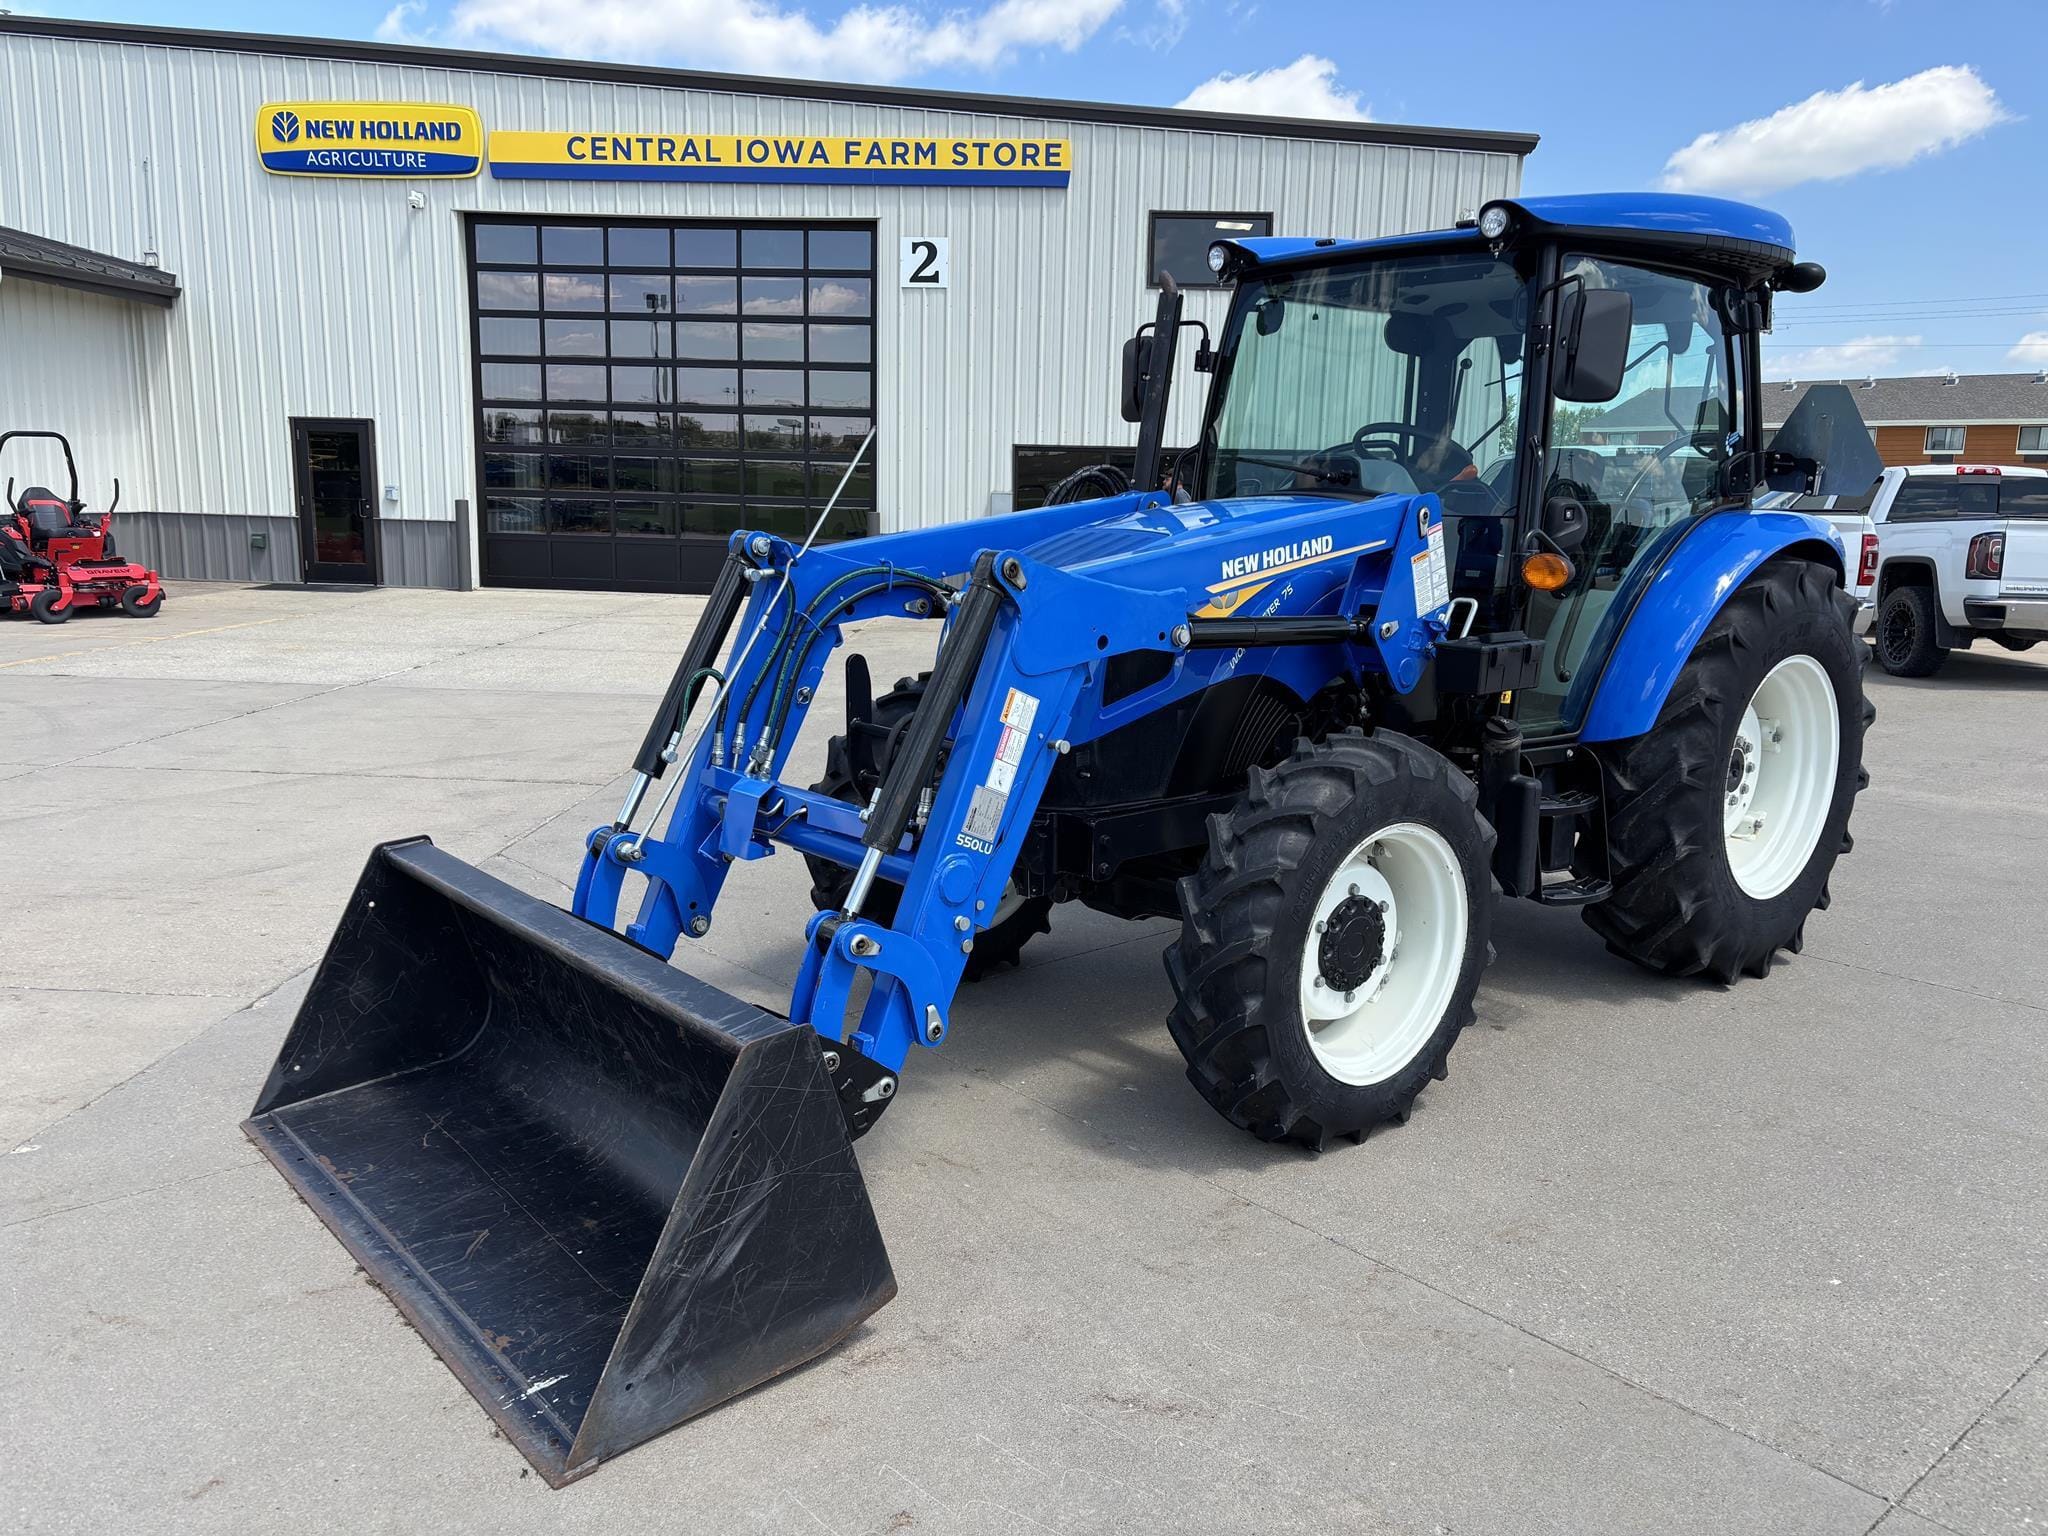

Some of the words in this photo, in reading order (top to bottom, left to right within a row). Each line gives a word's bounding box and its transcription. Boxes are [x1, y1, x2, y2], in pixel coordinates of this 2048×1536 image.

[305, 120, 354, 139] NEW
[360, 121, 462, 141] HOLLAND
[306, 151, 427, 168] AGRICULTURE
[566, 136, 722, 163] CENTRAL
[737, 139, 830, 165] IOWA
[844, 141, 937, 166] FARM
[951, 142, 1062, 167] STORE
[909, 240, 940, 284] 2
[1222, 553, 1260, 580] NEW
[1262, 535, 1333, 569] HOLLAND
[1281, 582, 1294, 600] 75
[955, 833, 994, 855] 550LU
